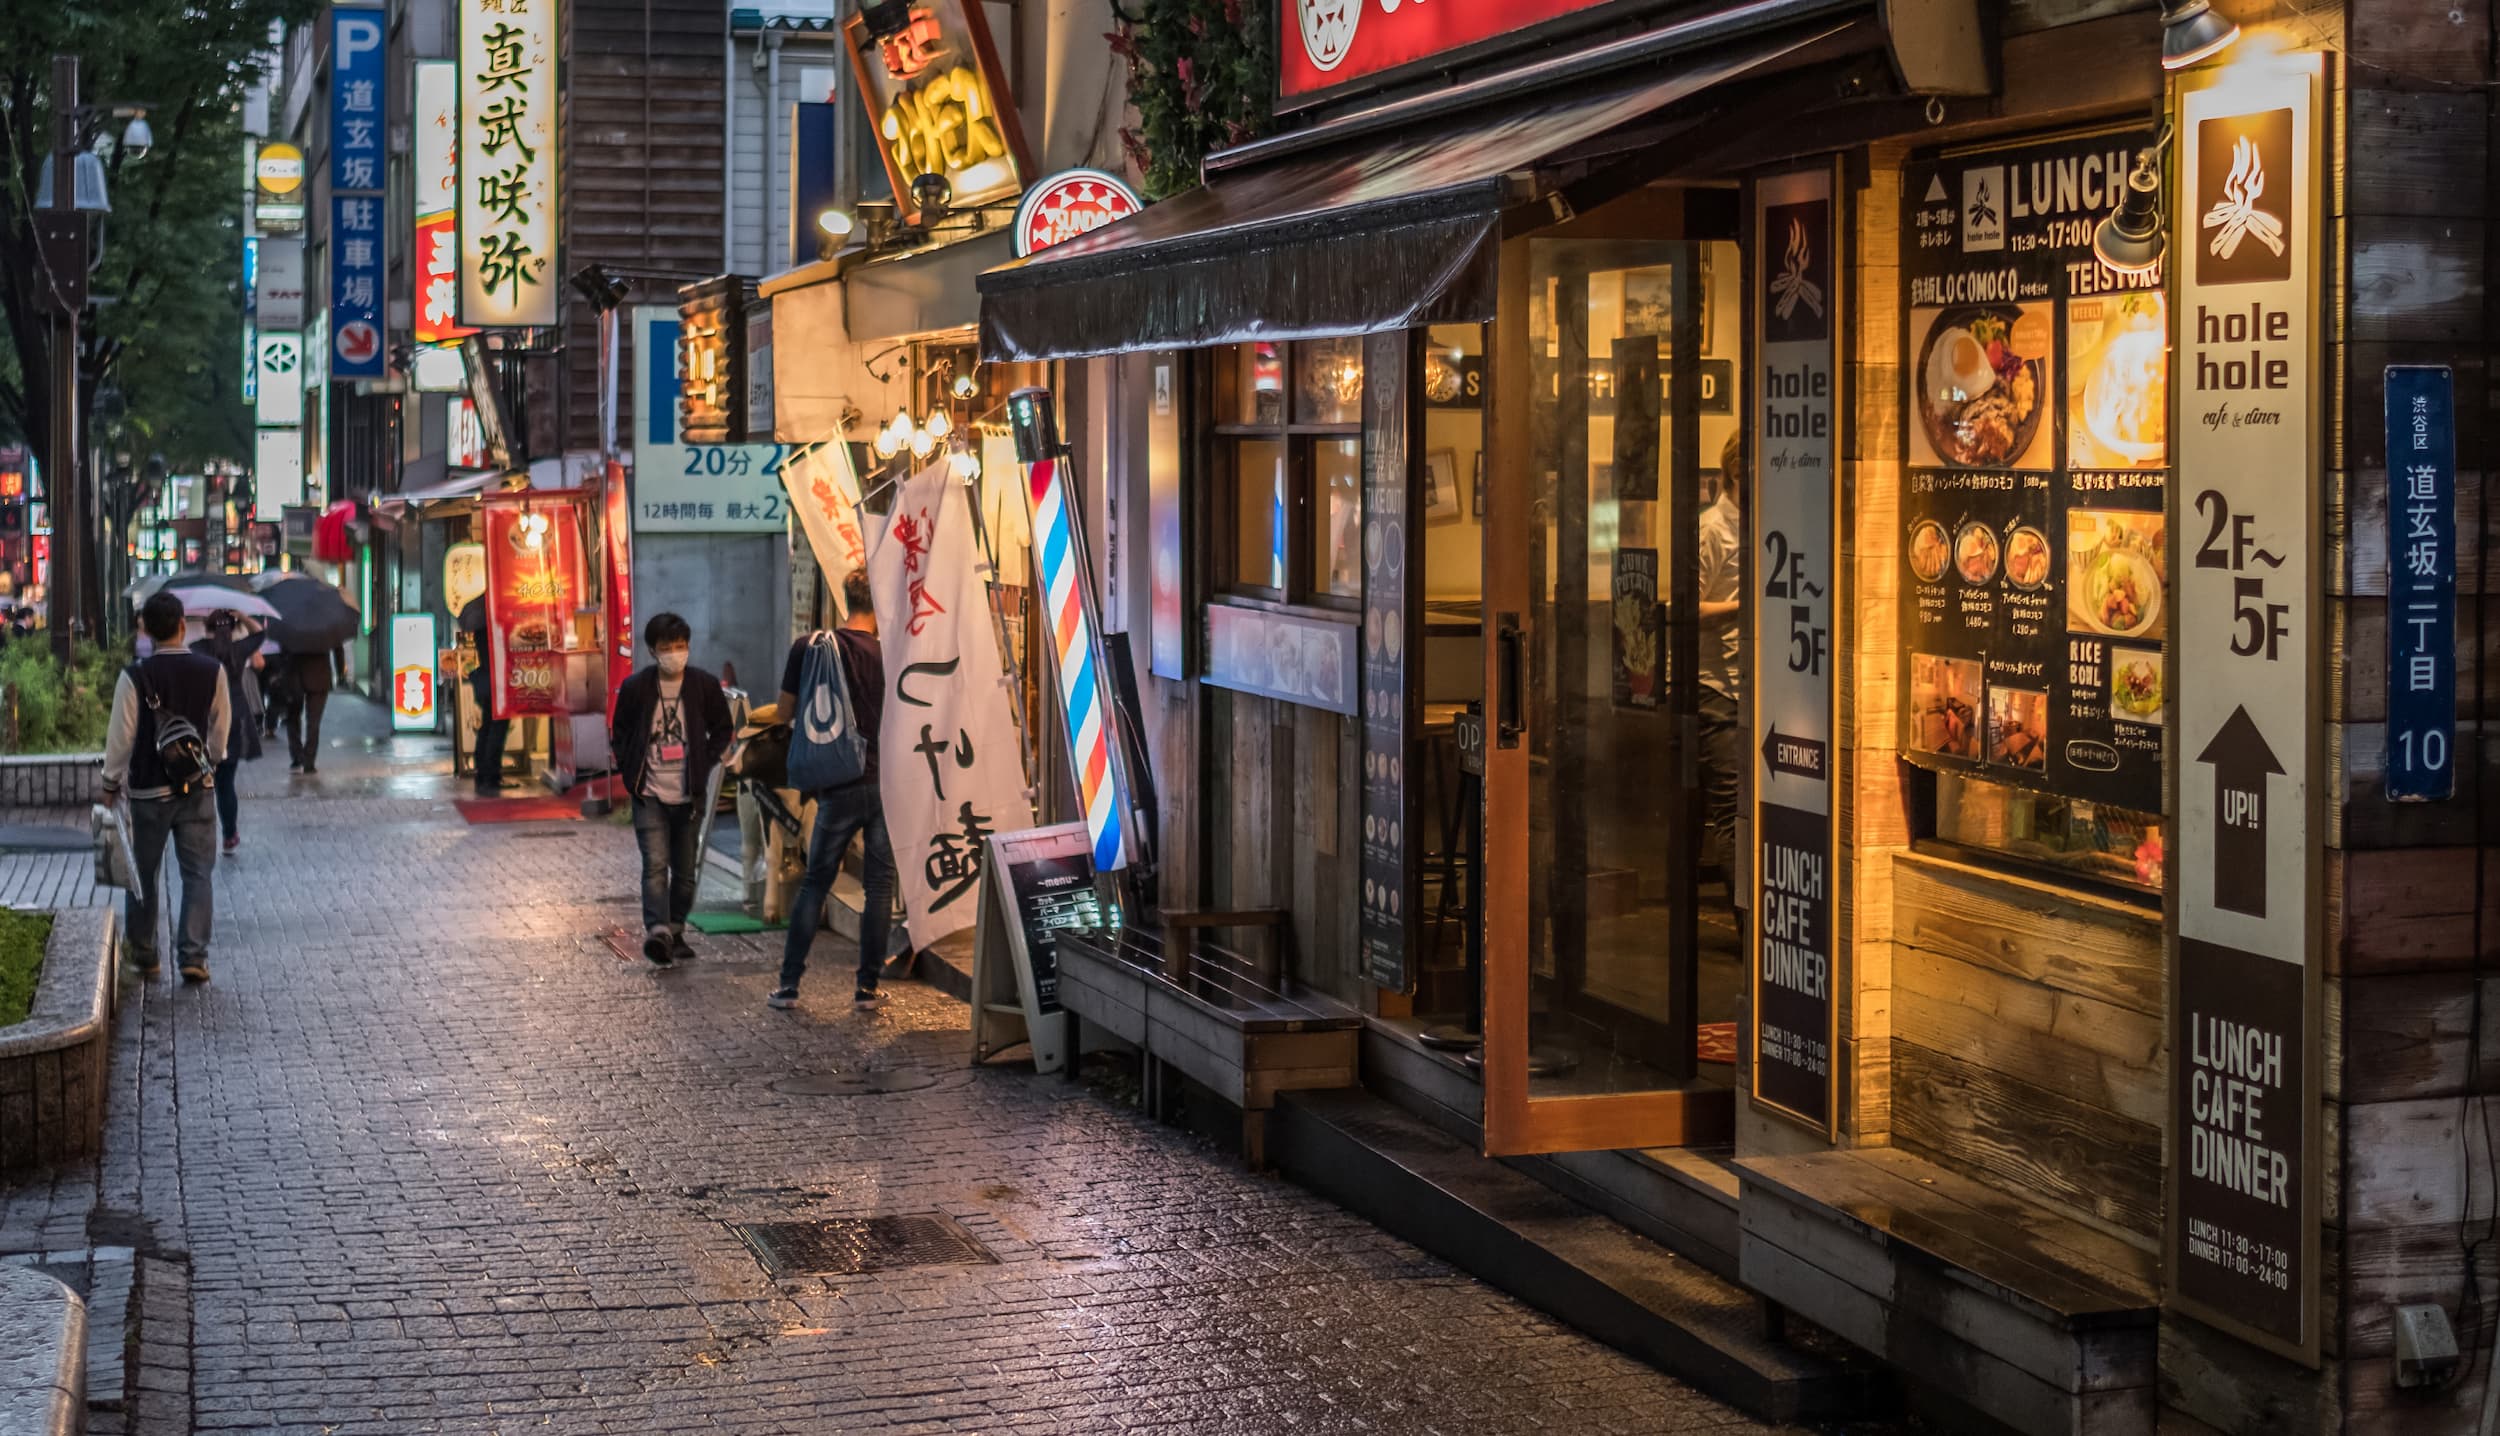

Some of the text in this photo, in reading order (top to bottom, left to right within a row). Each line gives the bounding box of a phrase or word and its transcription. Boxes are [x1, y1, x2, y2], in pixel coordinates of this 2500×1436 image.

[337, 20, 380, 70] P
[476, 22, 538, 309] 真武咲弥
[2010, 150, 2128, 219] LUNCH
[341, 80, 376, 306] 道玄坂駐車場
[2196, 302, 2289, 344] hole
[1765, 363, 1827, 399] hole
[2196, 350, 2289, 390] hole
[1765, 404, 1827, 438] hole
[2202, 402, 2229, 431] cafe
[2244, 406, 2281, 426] diner
[2411, 396, 2429, 450] 渋谷区
[684, 446, 752, 477] 20分
[643, 502, 715, 521] 12時間毎
[1364, 487, 1402, 514] TAKE OUT
[2406, 465, 2438, 692] 道玄坂二丁目
[2230, 575, 2290, 661] 5F
[1788, 605, 1826, 676] 5F
[2069, 640, 2102, 664] RICE
[2069, 663, 2102, 687] BOWL
[1776, 742, 1820, 770] ENTRANCE
[2399, 729, 2447, 773] 10
[2223, 788, 2258, 830] UP!!
[1763, 842, 1823, 900] LUNCH
[1763, 890, 1811, 946] CAFE
[1763, 937, 1827, 1001] DINNER
[1761, 1022, 1782, 1043] LUNCH
[1761, 1038, 1783, 1061] DINNER
[2191, 1011, 2282, 1089] LUNCH
[2191, 1069, 2263, 1142] CAFE
[2191, 1124, 2289, 1209] DINNER
[2188, 1216, 2219, 1244] LUNCH
[2188, 1236, 2220, 1265] DINNER
